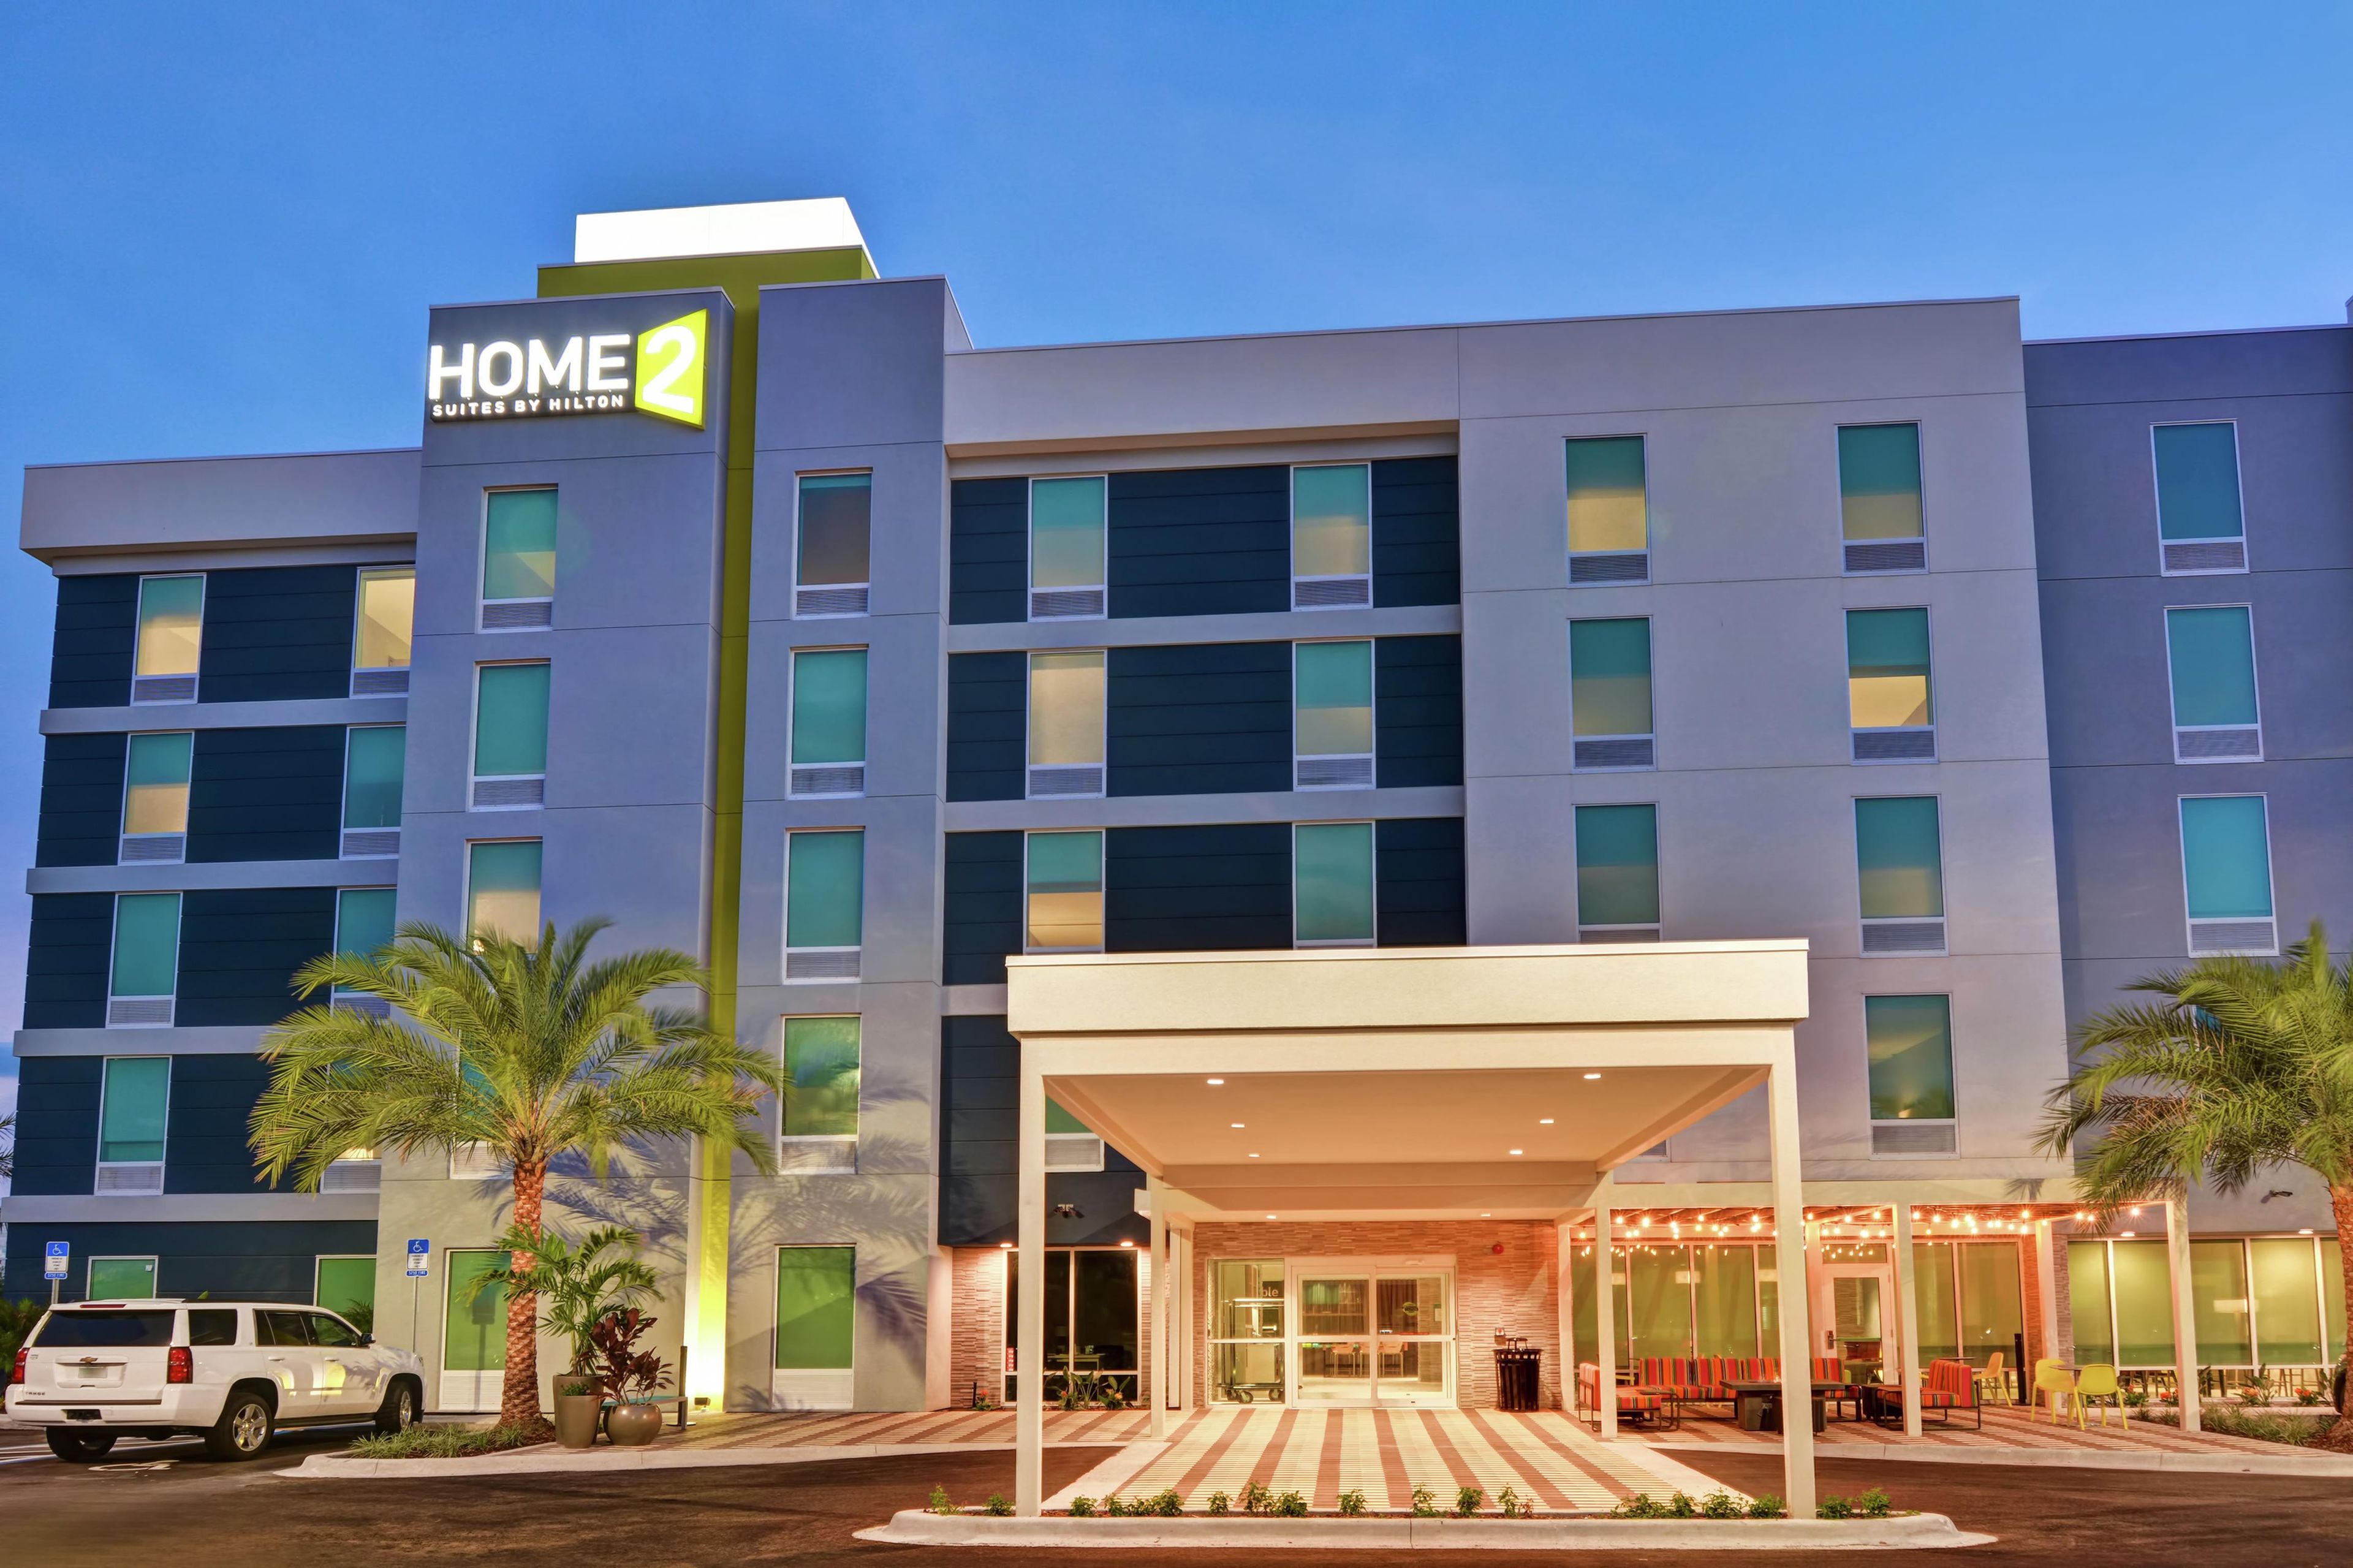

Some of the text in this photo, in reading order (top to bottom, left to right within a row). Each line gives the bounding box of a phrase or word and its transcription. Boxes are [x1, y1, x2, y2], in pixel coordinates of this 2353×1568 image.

[429, 325, 696, 414] HOME 2
[432, 395, 623, 417] SUITES BY HILTON
